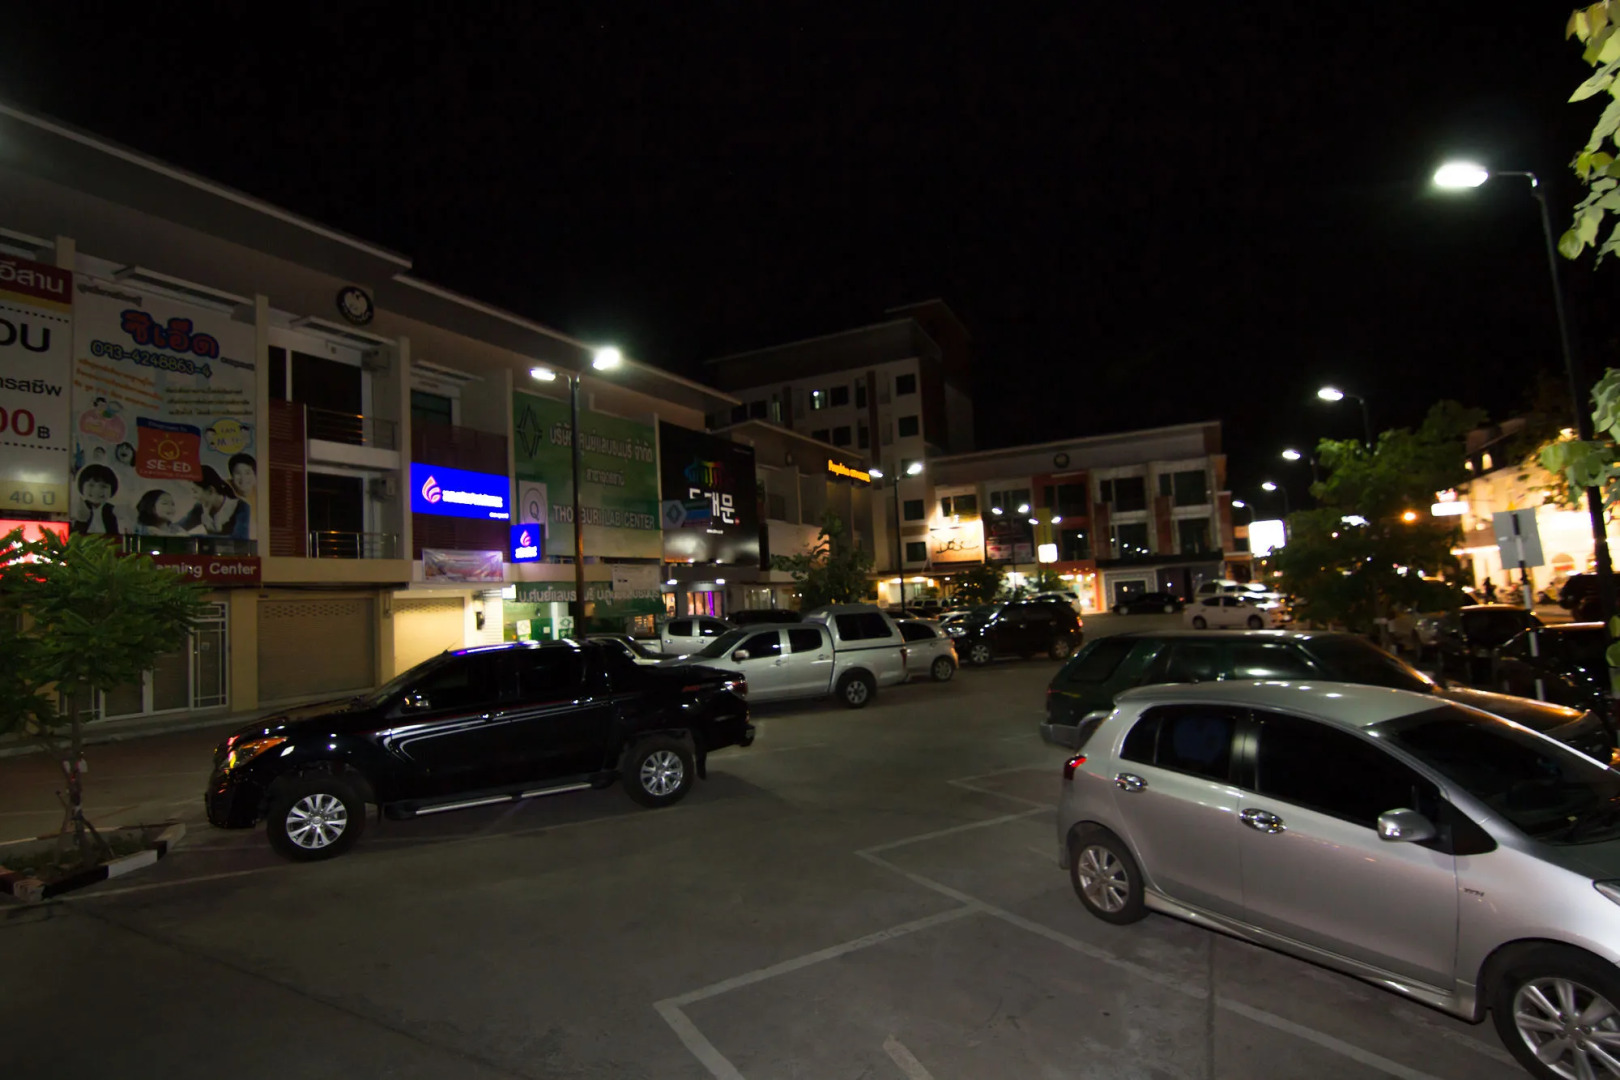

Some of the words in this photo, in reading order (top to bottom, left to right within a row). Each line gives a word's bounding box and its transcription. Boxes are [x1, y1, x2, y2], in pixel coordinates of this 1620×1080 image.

[146, 459, 192, 473] SE-ED
[553, 504, 603, 525] THOBURI
[209, 562, 257, 575] Center
